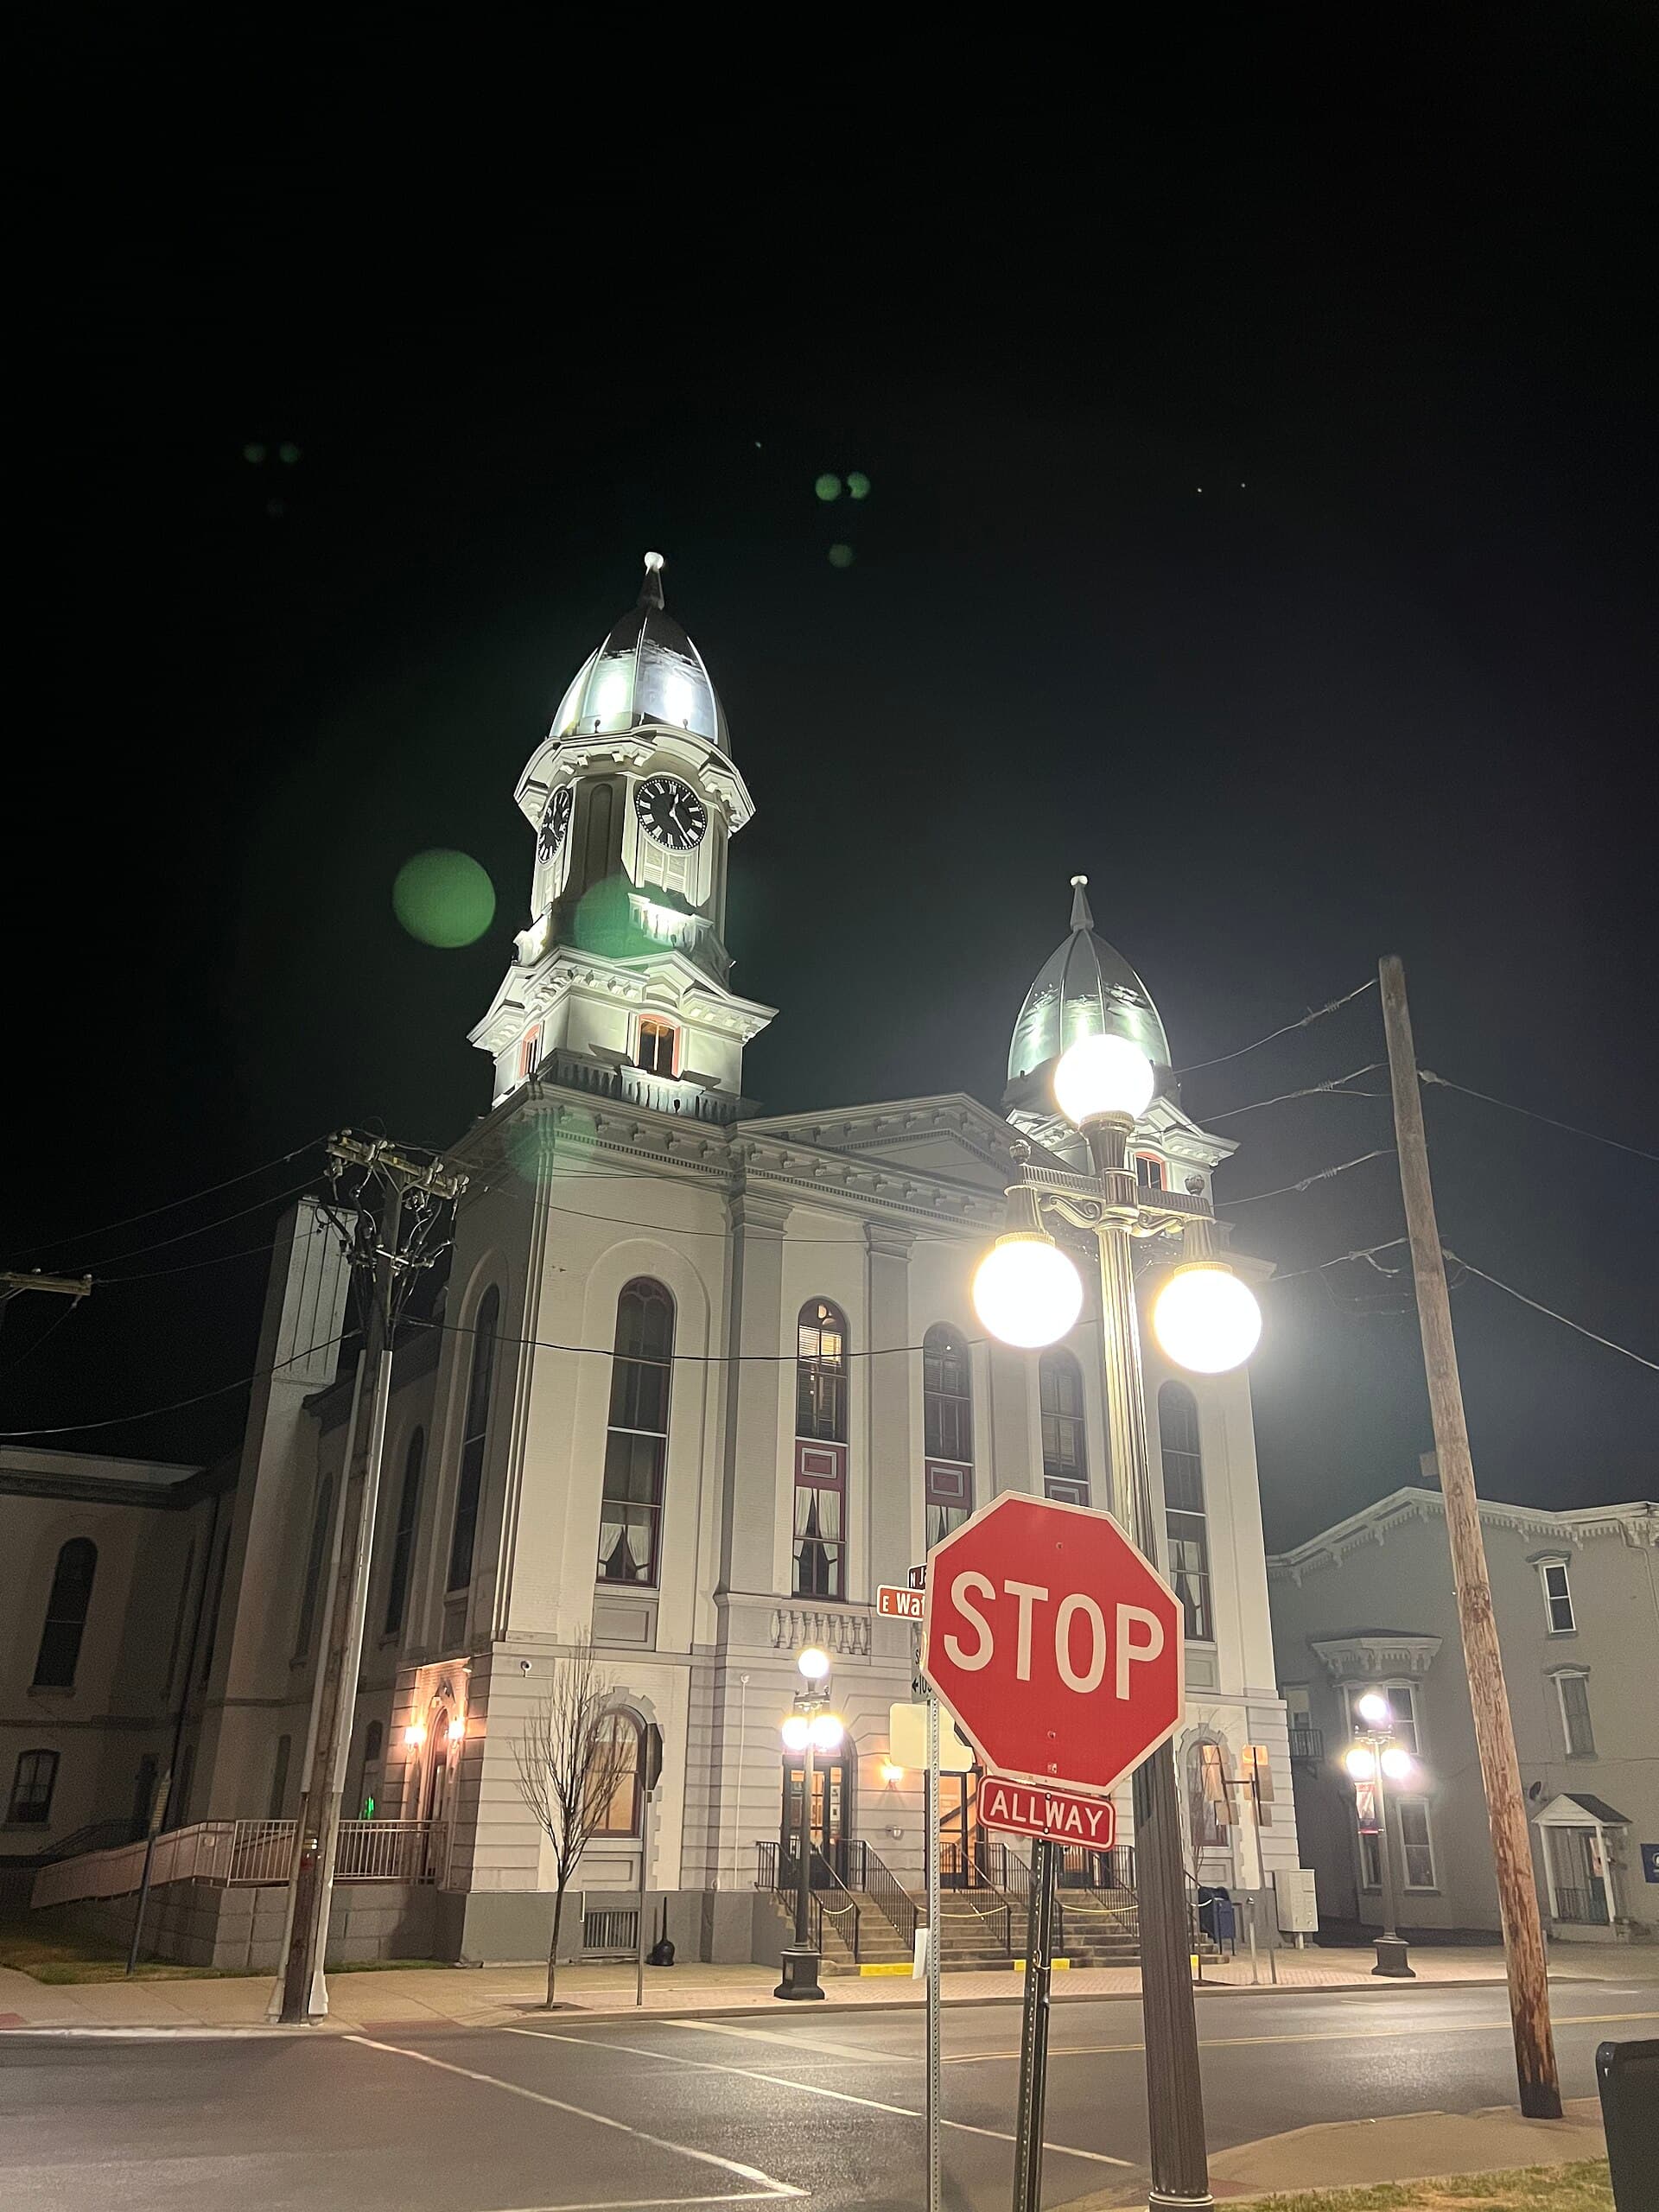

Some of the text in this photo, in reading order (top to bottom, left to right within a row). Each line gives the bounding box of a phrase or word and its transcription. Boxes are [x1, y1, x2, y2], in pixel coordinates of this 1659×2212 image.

[910, 1567, 927, 1587] N J
[882, 1595, 890, 1612] E
[944, 1571, 1165, 1700] STOP
